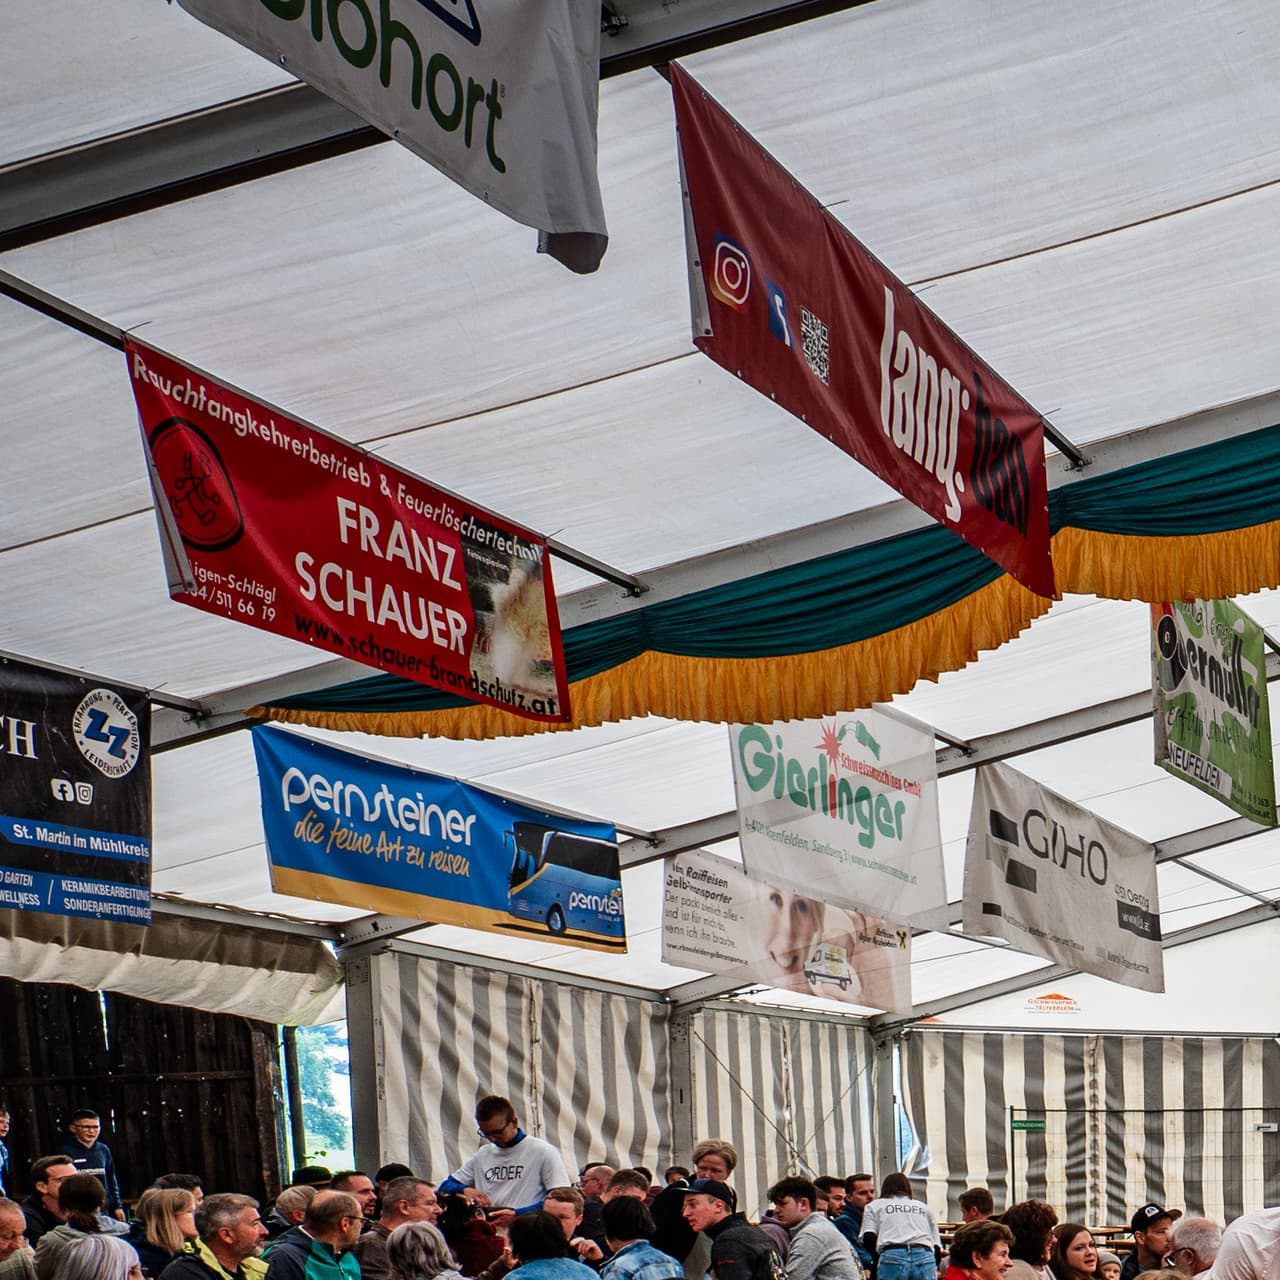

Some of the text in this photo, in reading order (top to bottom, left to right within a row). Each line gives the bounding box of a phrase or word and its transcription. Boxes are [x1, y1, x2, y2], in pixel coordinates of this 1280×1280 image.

[257, 0, 506, 173] ohort
[133, 353, 371, 488] Rauchfangkehrerbetrieb
[379, 472, 392, 498] &
[336, 496, 462, 591] FRANZ
[188, 560, 276, 602] igen-Schlägl
[295, 551, 468, 656] SCHAUER
[237, 601, 255, 617] 66
[262, 605, 276, 622] 19
[294, 611, 557, 715] www.schauer-brandschutz.at
[75, 691, 103, 735] ERFAHRUNG
[112, 698, 139, 751] PERFEKTION
[0, 714, 39, 760] H
[84, 749, 132, 776] LEIDENSCHAFT
[1169, 742, 1223, 790] NEUFELDEN
[281, 767, 476, 846] pernsteiner
[738, 725, 906, 849] Gierlinger
[12, 823, 150, 858] St. Martin im Mühlkreis
[294, 809, 471, 878] die feine Art zu reisen
[1023, 808, 1108, 886] GIHO
[4, 871, 33, 887] GARTEN
[665, 890, 678, 903] Der
[686, 866, 728, 888] Raiffeisen
[686, 925, 697, 938] ich
[485, 1166, 524, 1180] ORDER
[885, 1204, 926, 1217] ORDER
